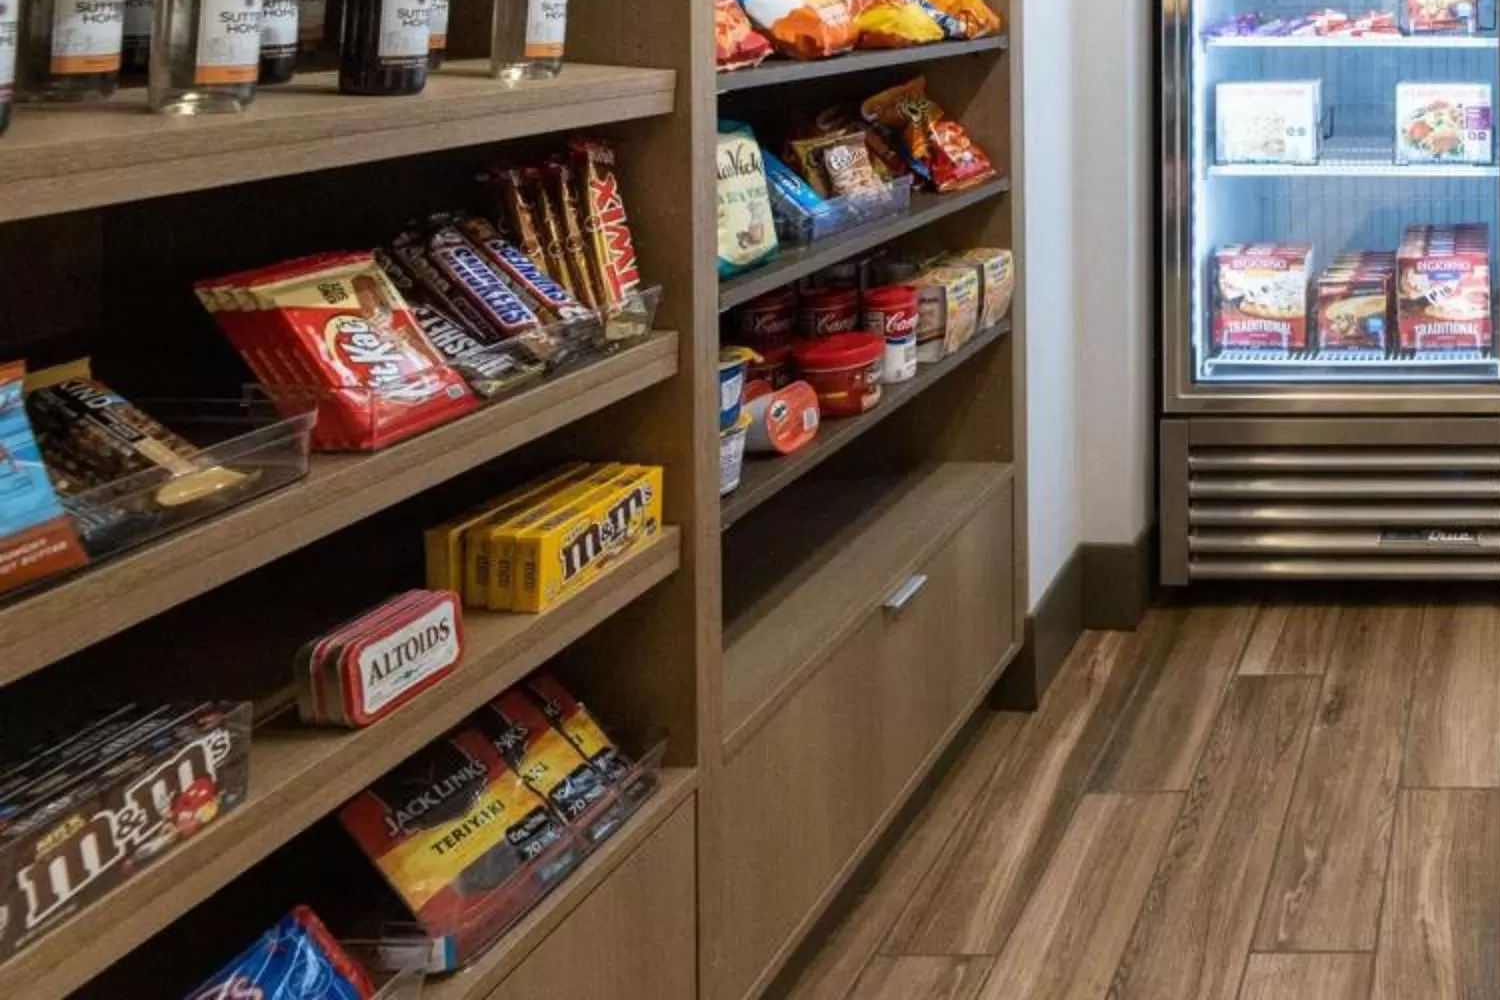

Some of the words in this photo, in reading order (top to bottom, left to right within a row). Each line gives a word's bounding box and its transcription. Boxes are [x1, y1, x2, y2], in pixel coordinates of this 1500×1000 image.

[588, 172, 641, 308] TWIX
[368, 616, 451, 686] ALTOIDS
[384, 791, 441, 837] JACK
[431, 799, 505, 856] TERIYAKI
